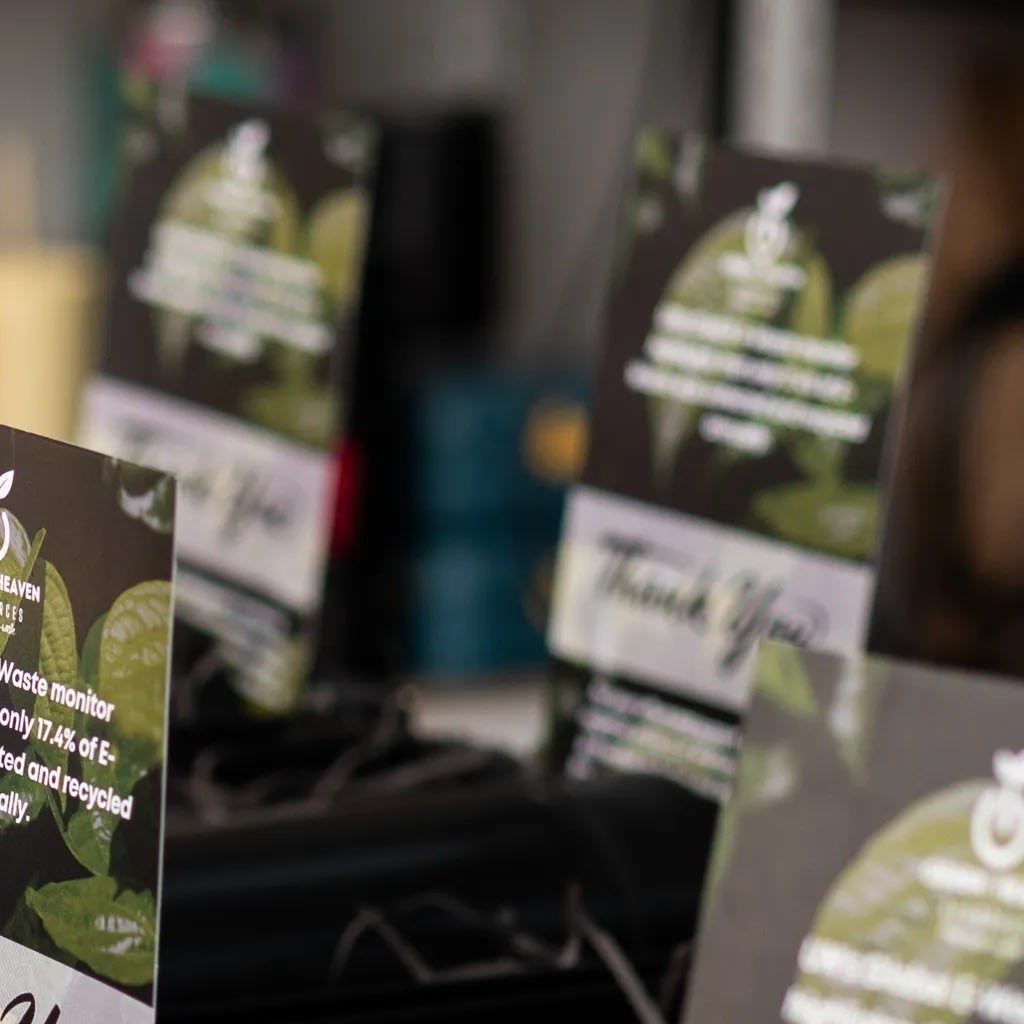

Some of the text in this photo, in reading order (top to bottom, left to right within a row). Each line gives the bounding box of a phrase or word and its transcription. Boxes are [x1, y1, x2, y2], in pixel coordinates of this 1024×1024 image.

[50, 681, 115, 722] monitor
[0, 706, 35, 740] only
[37, 716, 76, 753] 17.4%
[79, 736, 98, 760] of
[98, 739, 116, 766] E-
[28, 760, 61, 791] and
[62, 774, 133, 820] recycled
